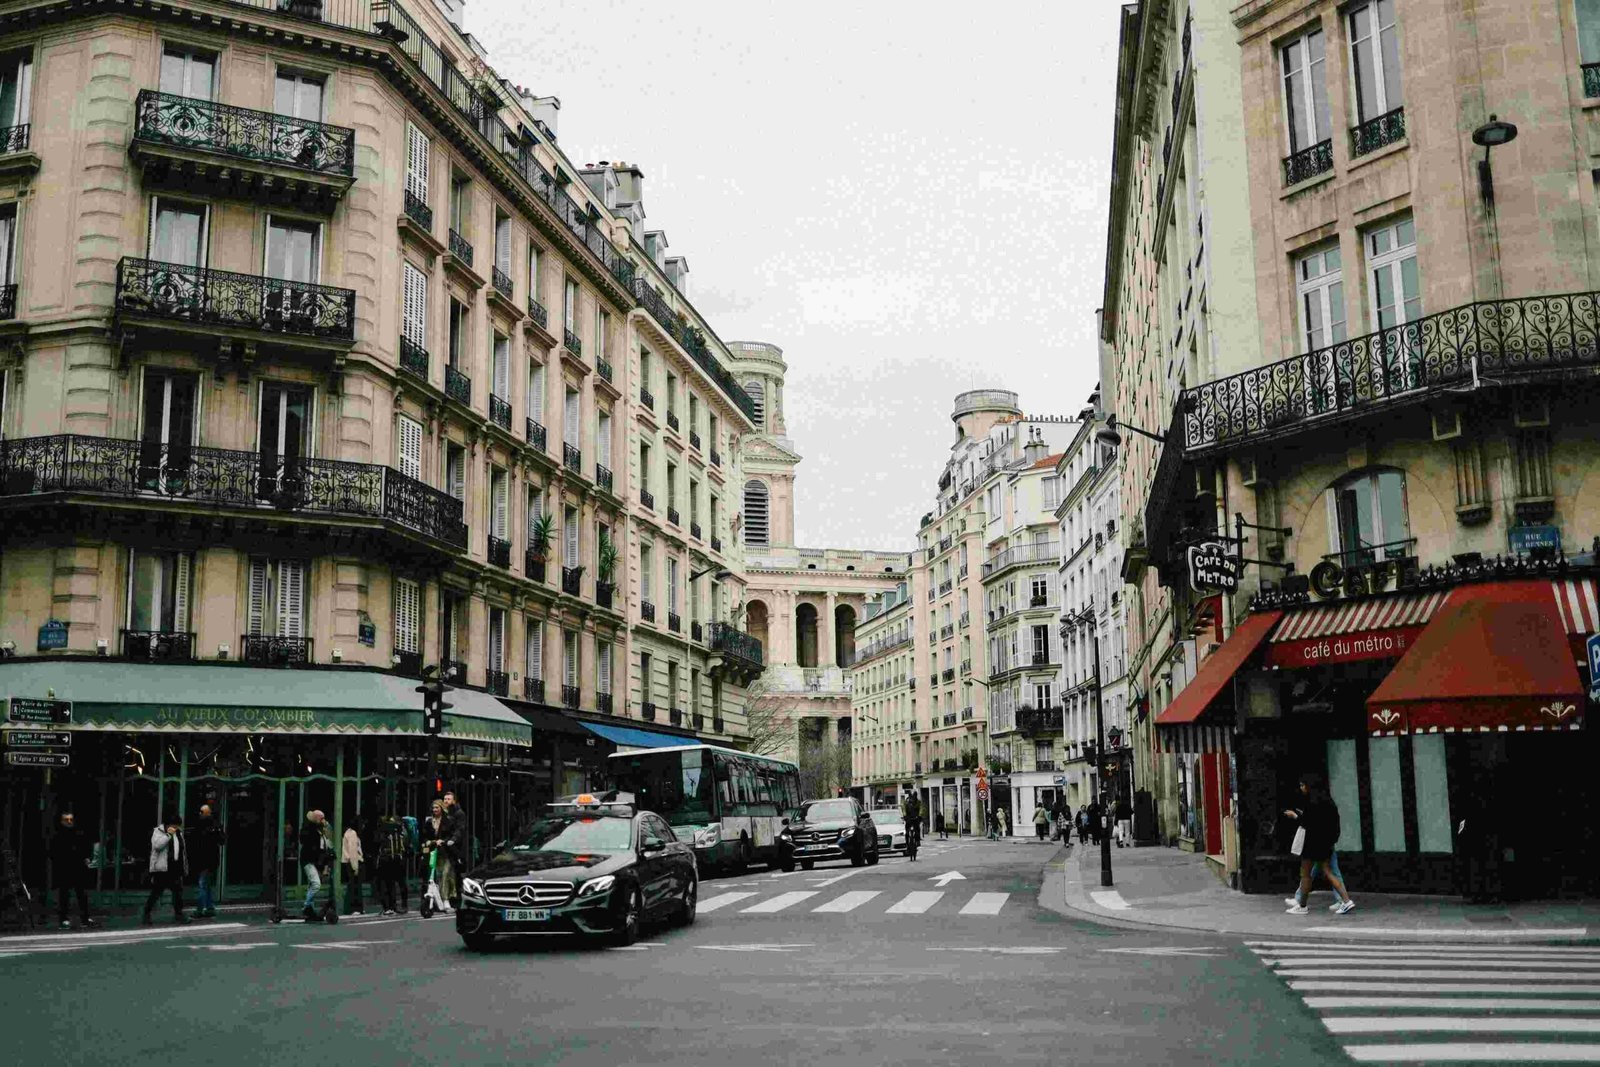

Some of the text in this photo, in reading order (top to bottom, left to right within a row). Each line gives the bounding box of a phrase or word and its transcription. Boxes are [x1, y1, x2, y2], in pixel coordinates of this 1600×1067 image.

[1223, 559, 1236, 573] DU
[1197, 569, 1234, 586] METRO
[1304, 641, 1331, 659] café
[1334, 640, 1350, 656] du
[1354, 635, 1393, 654] métro
[157, 707, 314, 722] AU VIEUX COLOMBIER
